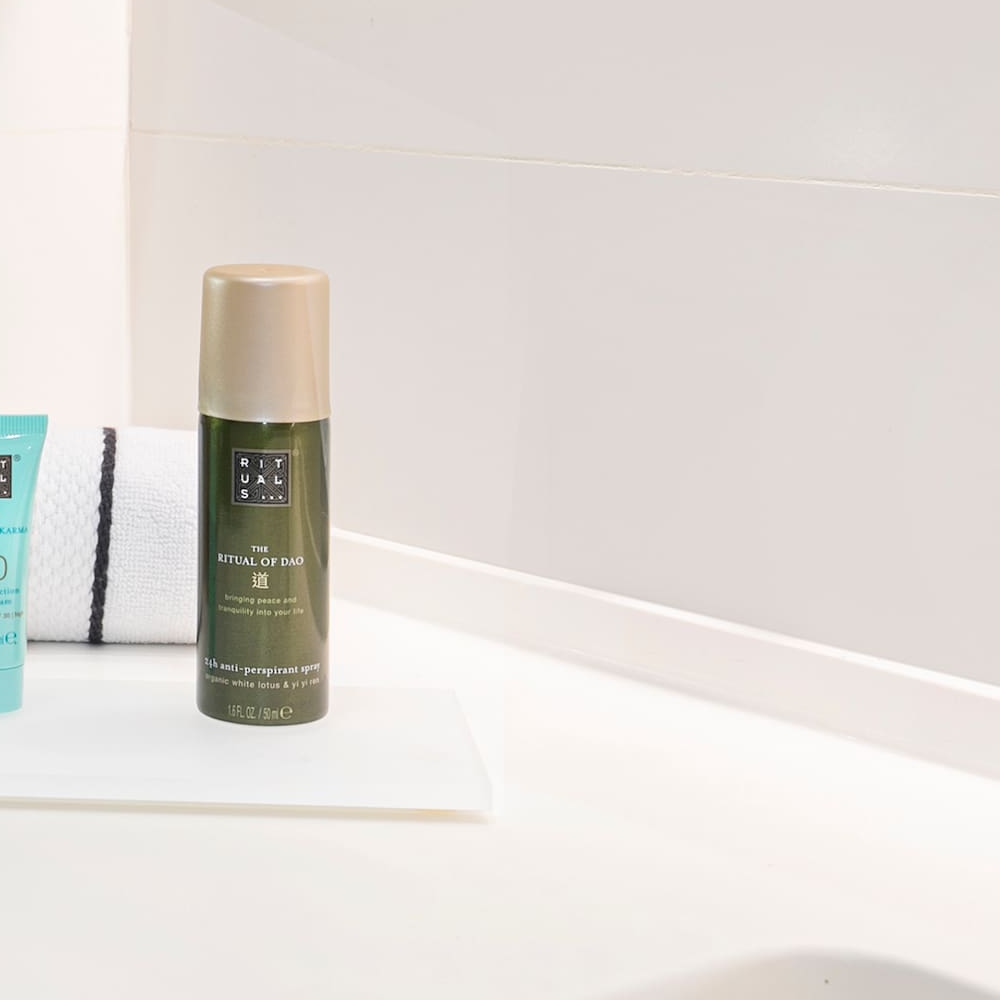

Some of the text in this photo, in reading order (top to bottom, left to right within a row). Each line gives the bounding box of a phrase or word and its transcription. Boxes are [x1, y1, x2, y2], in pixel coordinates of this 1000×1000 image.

[251, 545, 269, 553] THE
[217, 553, 304, 567] RITUAL OF DAO
[252, 571, 269, 589] 道
[224, 593, 297, 605] bringing peace and
[218, 604, 304, 617] tranquility into your life
[220, 663, 298, 677] anti-perspirant
[300, 662, 321, 675] spray
[231, 680, 255, 689] white
[258, 680, 280, 689] lotus
[283, 680, 289, 689] &
[291, 682, 299, 690] yi
[301, 680, 308, 689] yi
